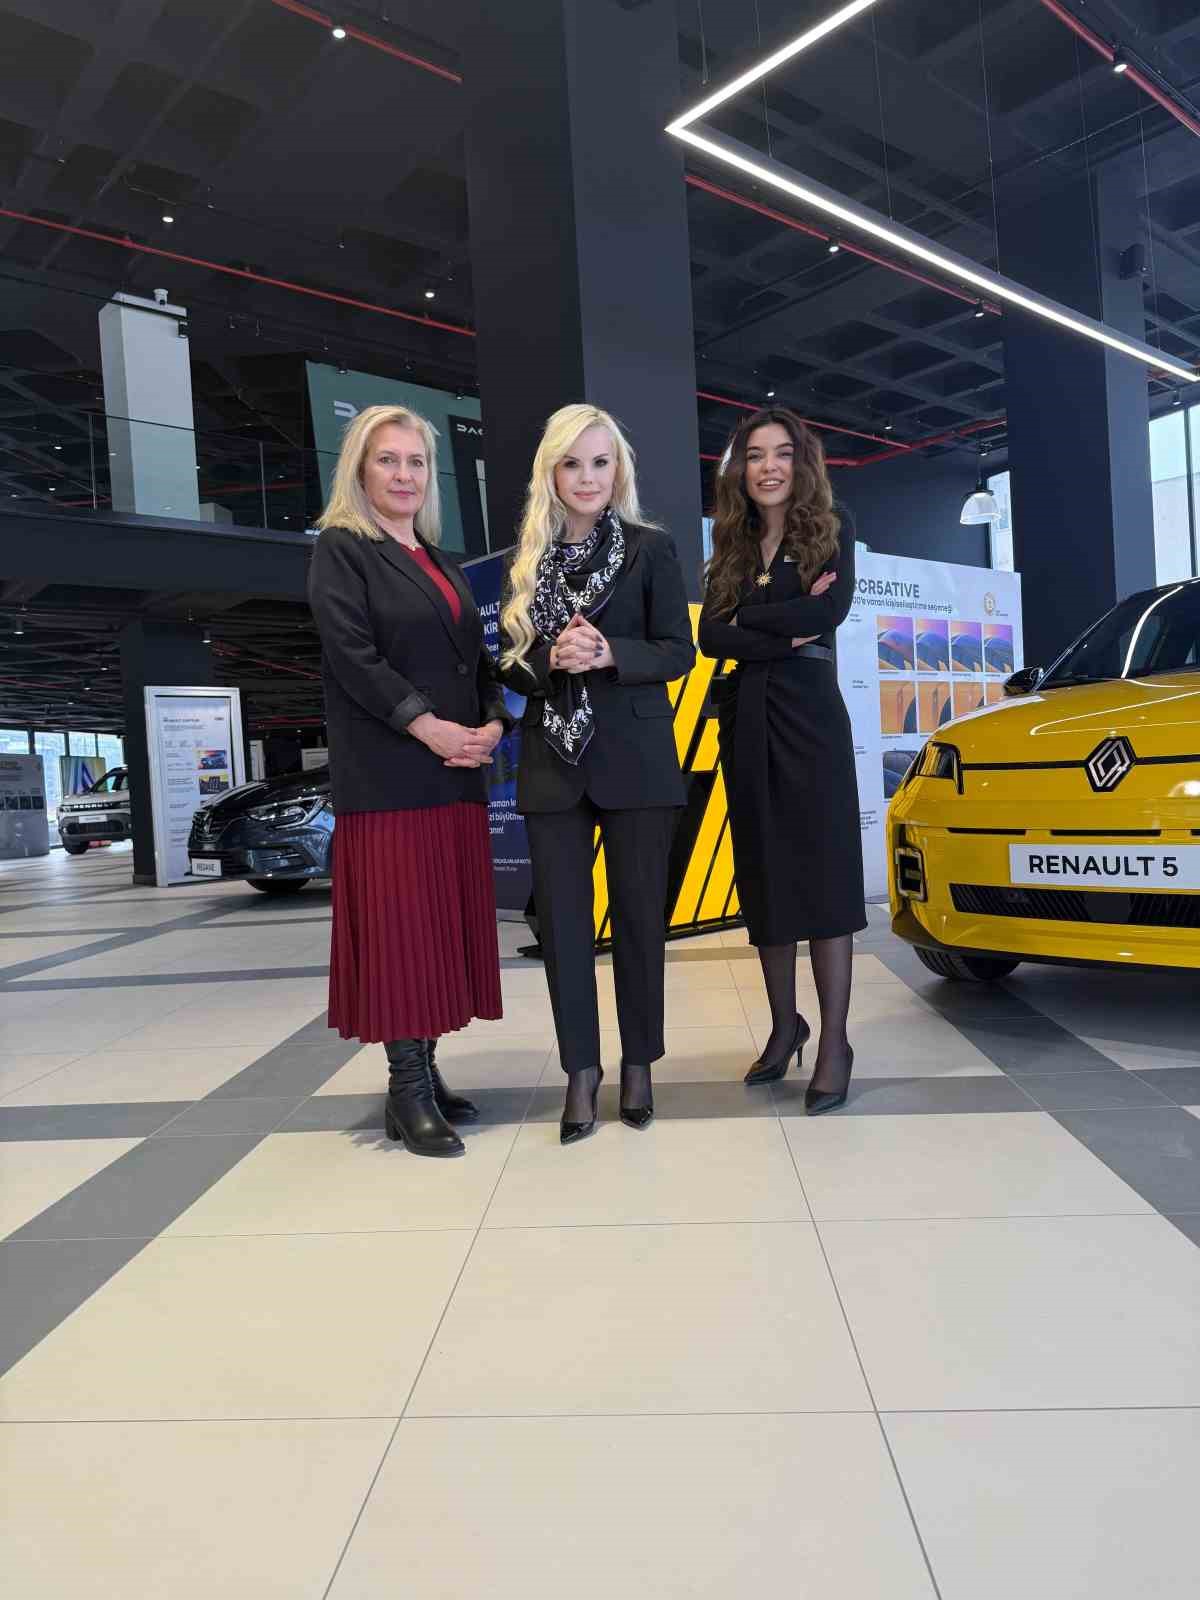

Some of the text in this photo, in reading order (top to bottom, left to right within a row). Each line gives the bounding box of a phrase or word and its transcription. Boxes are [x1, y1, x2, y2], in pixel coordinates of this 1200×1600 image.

[855, 578, 920, 598] CR5ATIVE
[1028, 854, 1179, 877] RENAULT 5
